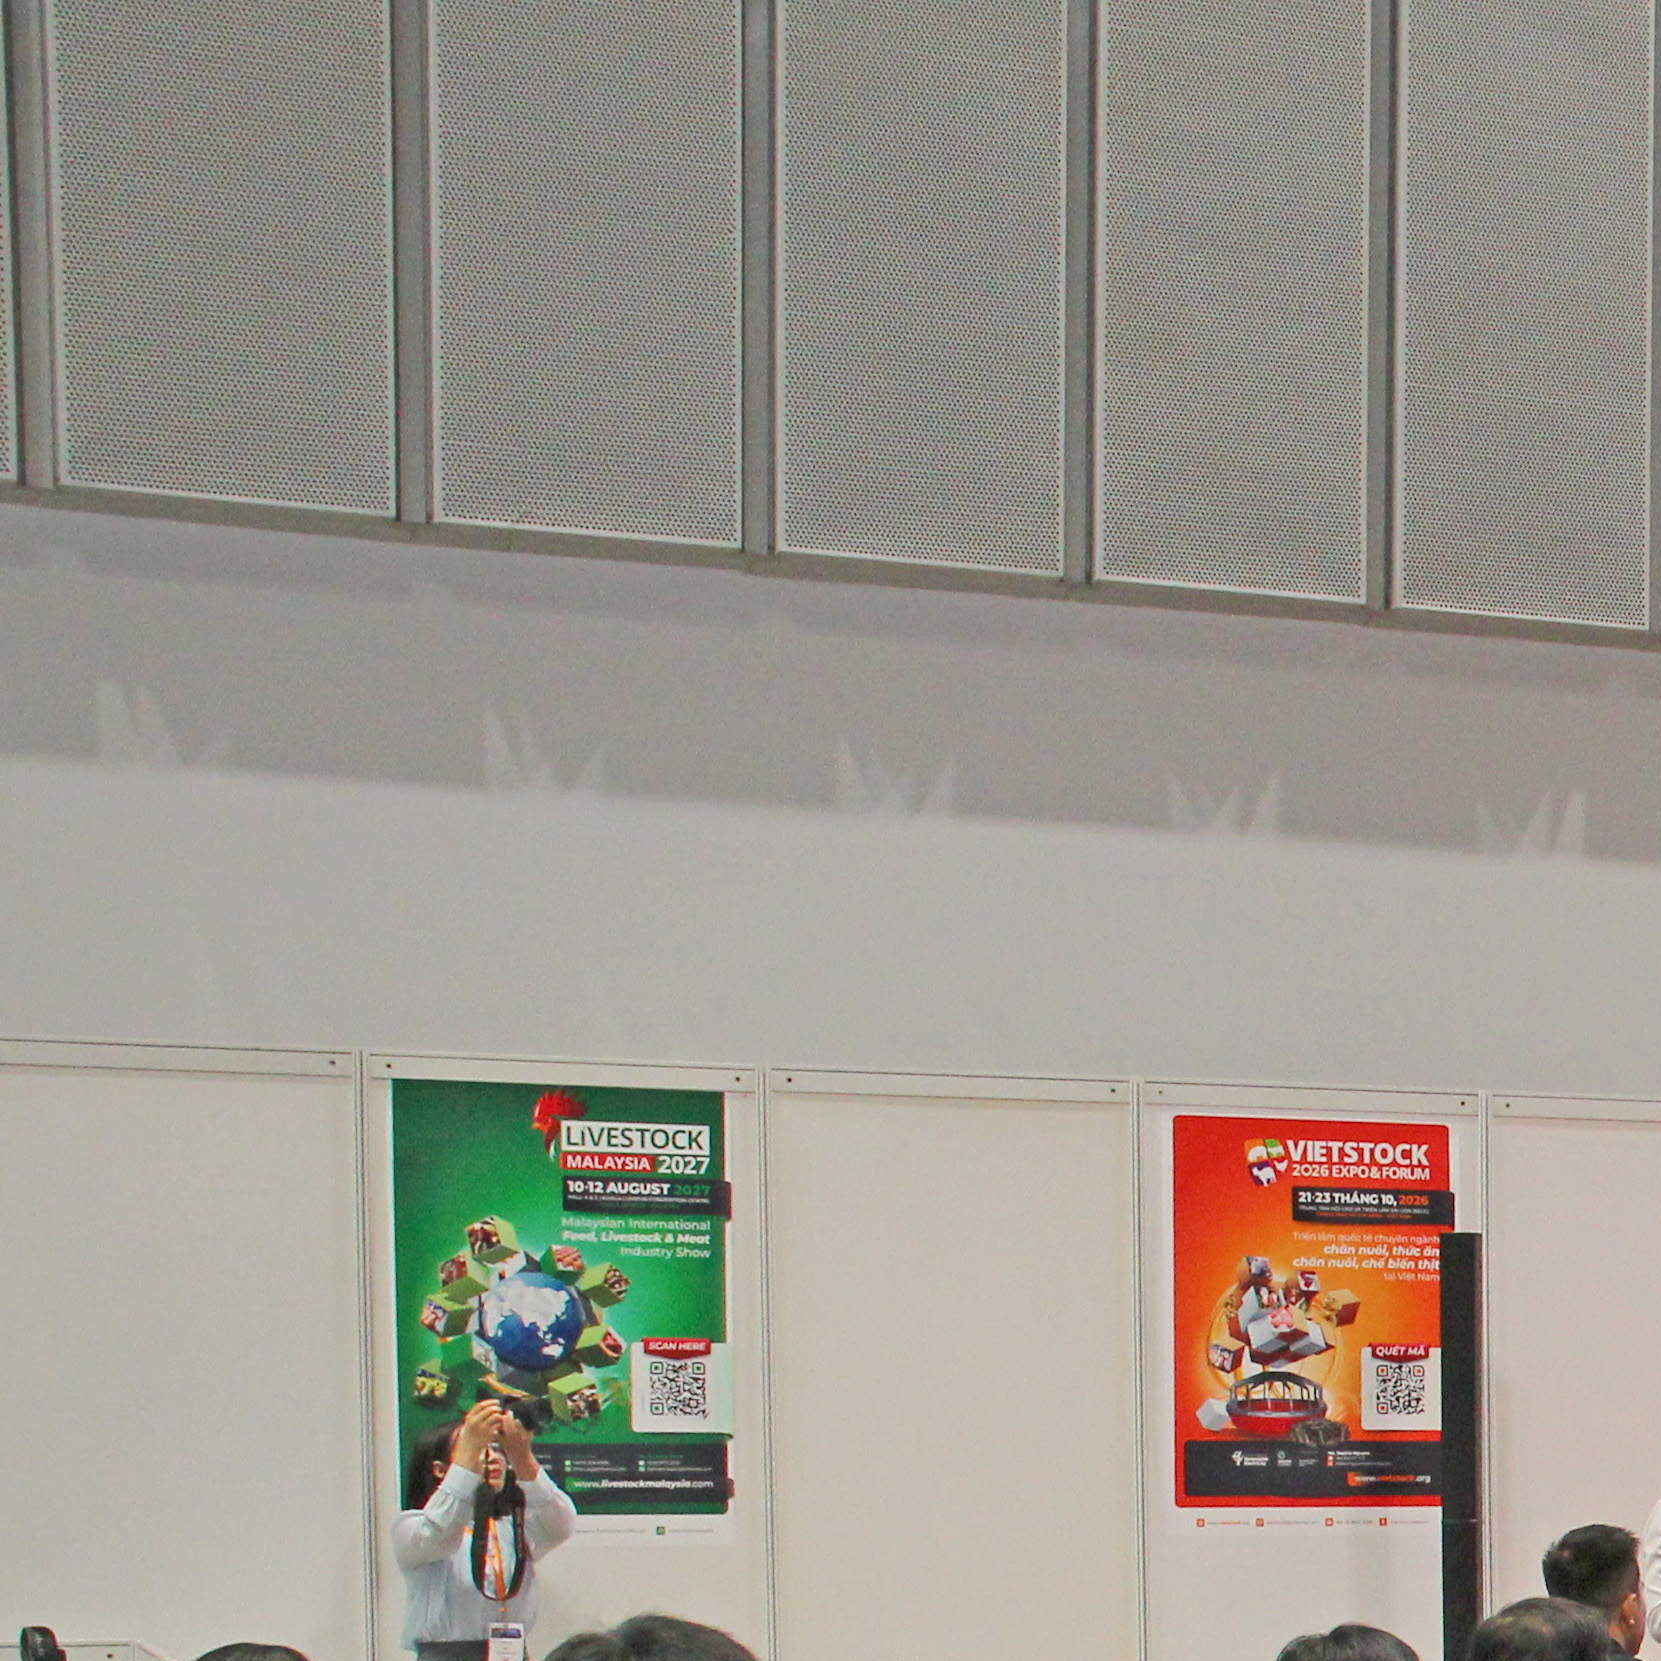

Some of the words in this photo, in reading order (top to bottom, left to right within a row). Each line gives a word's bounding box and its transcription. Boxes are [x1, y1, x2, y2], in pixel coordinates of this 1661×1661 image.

[1286, 1139, 1430, 1167] VIETSTOCK
[567, 1155, 651, 1171] MALAYSIA
[657, 1156, 711, 1175] 2027
[1292, 1164, 1329, 1177] 2026
[606, 1183, 671, 1195] AUGUST
[674, 1185, 711, 1196] 2027
[1333, 1190, 1379, 1205] THÁNG
[1381, 1195, 1398, 1206] 10,
[1399, 1195, 1430, 1206] 2026
[561, 1217, 625, 1229] Malaysian
[629, 1218, 711, 1231] International
[562, 1231, 597, 1243] Feed,
[601, 1231, 662, 1243] Livestock
[677, 1234, 711, 1245] Meat
[621, 1247, 672, 1259] Industry
[676, 1247, 711, 1258] Show
[648, 1342, 676, 1351] SCAN
[678, 1342, 706, 1351] HERE
[1375, 1343, 1406, 1357] QUÉT
[1407, 1344, 1425, 1357] MÃ
